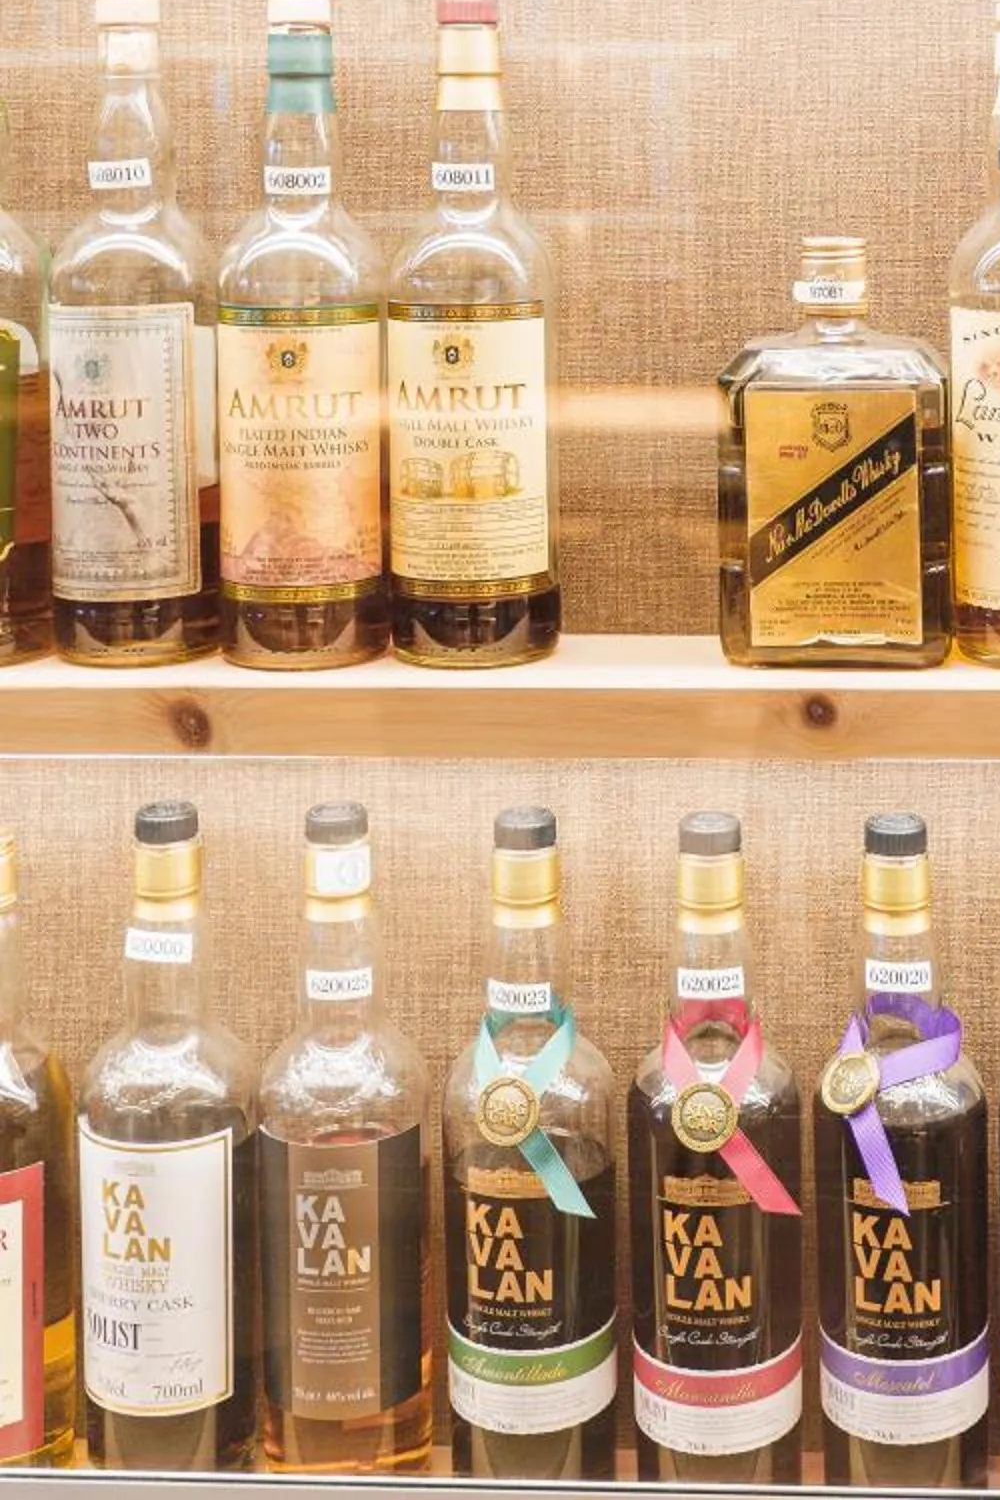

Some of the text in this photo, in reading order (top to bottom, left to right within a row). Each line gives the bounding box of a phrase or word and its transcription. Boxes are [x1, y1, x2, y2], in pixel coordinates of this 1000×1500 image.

[56, 395, 148, 419] AMRUT
[228, 388, 364, 420] AMRUT
[396, 380, 527, 414] AMRUT
[74, 423, 119, 440] TWO
[427, 416, 534, 434] MALT WHISKY
[263, 439, 370, 459] MALT WHISKY
[413, 436, 500, 449] DOUBLE CASK
[681, 972, 743, 993] 620022
[869, 968, 929, 986] 620020
[101, 1179, 145, 1210] KA
[296, 1194, 345, 1223] KA
[102, 1209, 146, 1236] VA
[297, 1222, 345, 1250] VA
[466, 1201, 524, 1240] KA
[663, 1210, 724, 1248] KA
[852, 1212, 913, 1251] KA
[102, 1236, 172, 1263] LAN
[296, 1246, 372, 1277] LAN
[469, 1233, 526, 1272] VA
[665, 1241, 724, 1280] VA
[854, 1245, 914, 1283] VA
[469, 1267, 554, 1303] LAN
[664, 1274, 753, 1311] LAN
[854, 1278, 942, 1315] LAN
[147, 1296, 194, 1312] CASK
